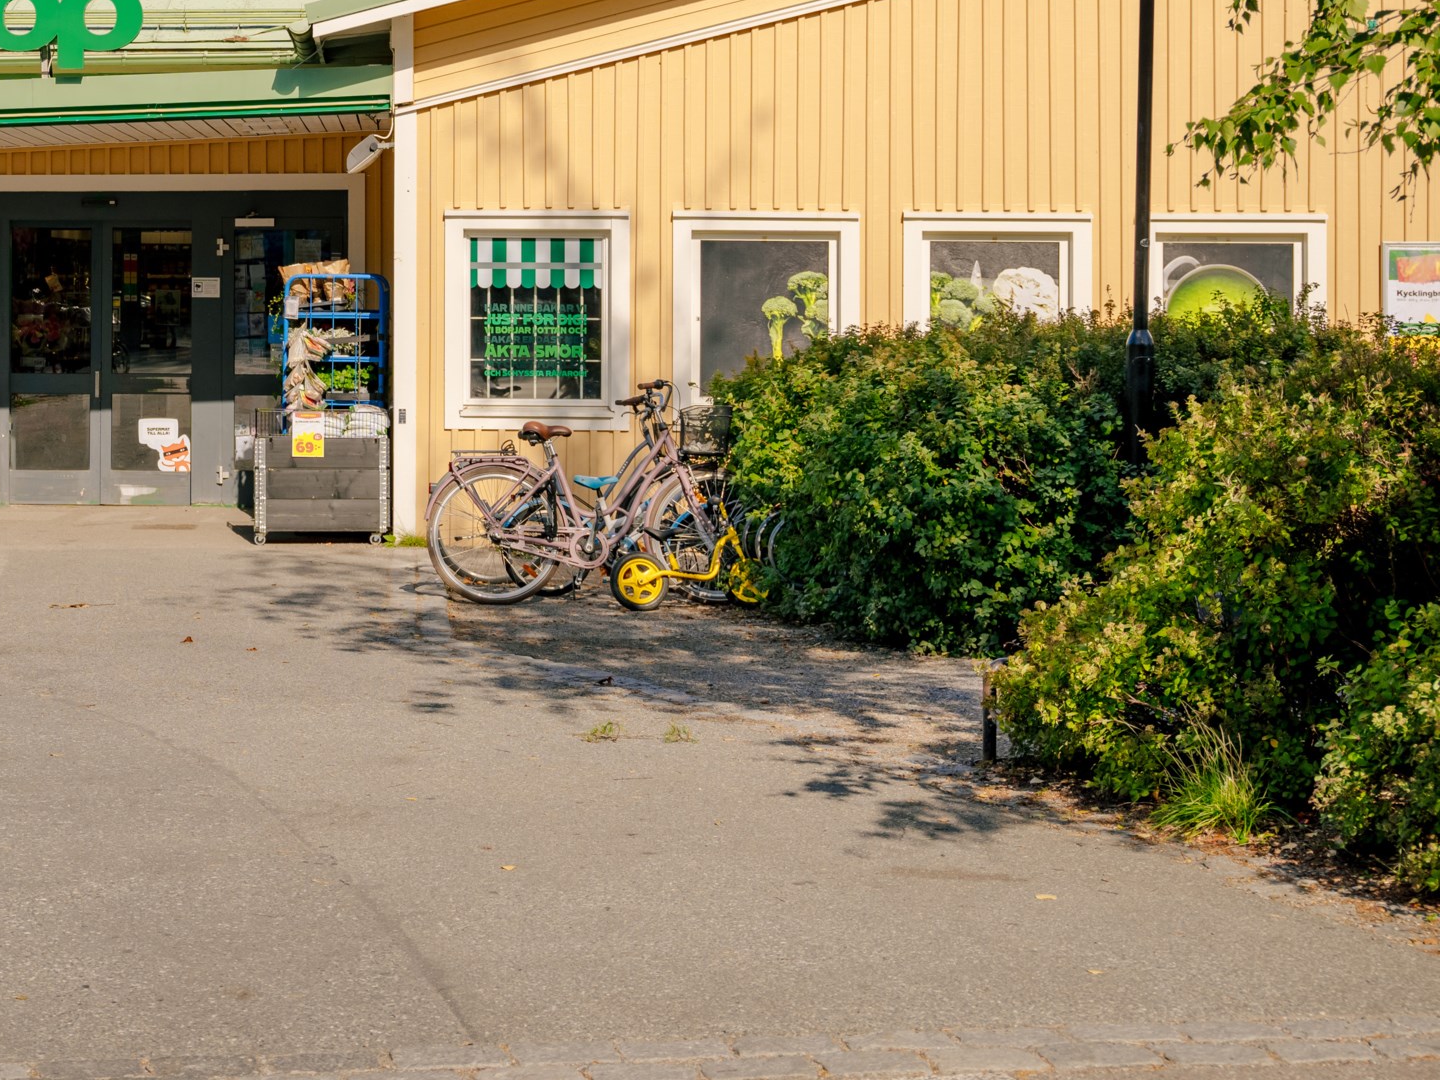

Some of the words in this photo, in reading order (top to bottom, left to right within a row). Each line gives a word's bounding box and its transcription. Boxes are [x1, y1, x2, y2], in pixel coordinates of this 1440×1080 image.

[484, 313, 520, 325] JUST
[523, 312, 555, 325] FÖR
[557, 314, 588, 325] DIG!
[495, 325, 531, 334] BÖRJAR
[537, 326, 567, 334] OTTAN
[484, 343, 530, 357] ÄKTA
[535, 343, 588, 360] SMÖR,
